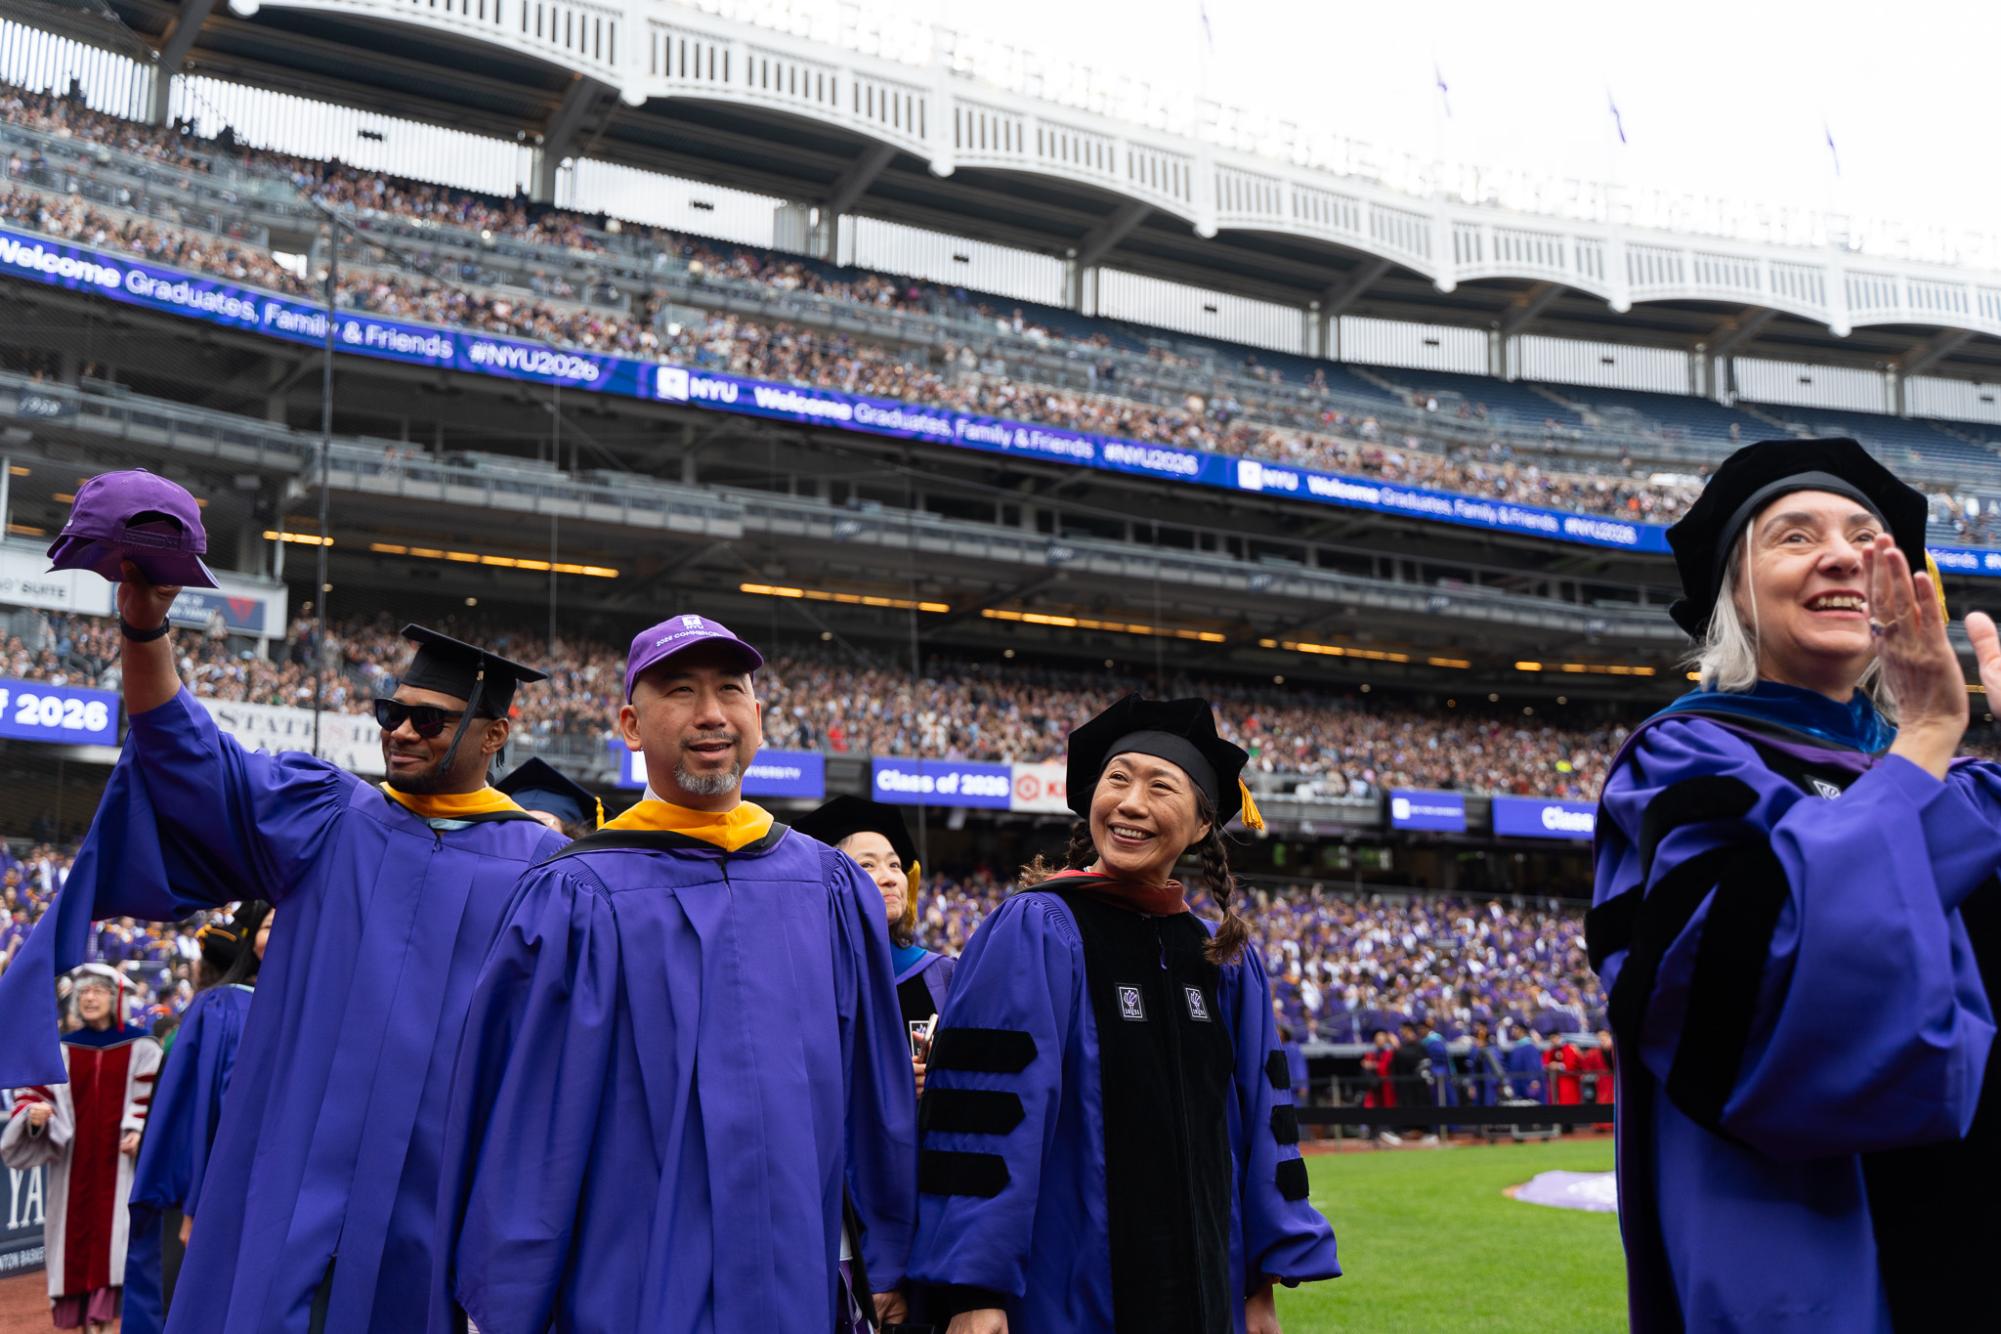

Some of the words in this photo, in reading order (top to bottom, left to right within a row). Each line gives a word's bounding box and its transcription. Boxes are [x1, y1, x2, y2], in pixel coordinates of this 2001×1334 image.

[125, 269, 259, 324] Graduates,
[342, 321, 363, 345] &
[365, 324, 454, 359] Friends
[468, 341, 600, 382] #NYU2026
[689, 376, 739, 404] NYU
[753, 385, 853, 421] Welcome
[955, 418, 1013, 449] Family
[1014, 427, 1029, 449] &
[14, 693, 109, 732] 2026
[876, 769, 936, 794] Class
[936, 772, 961, 794] of
